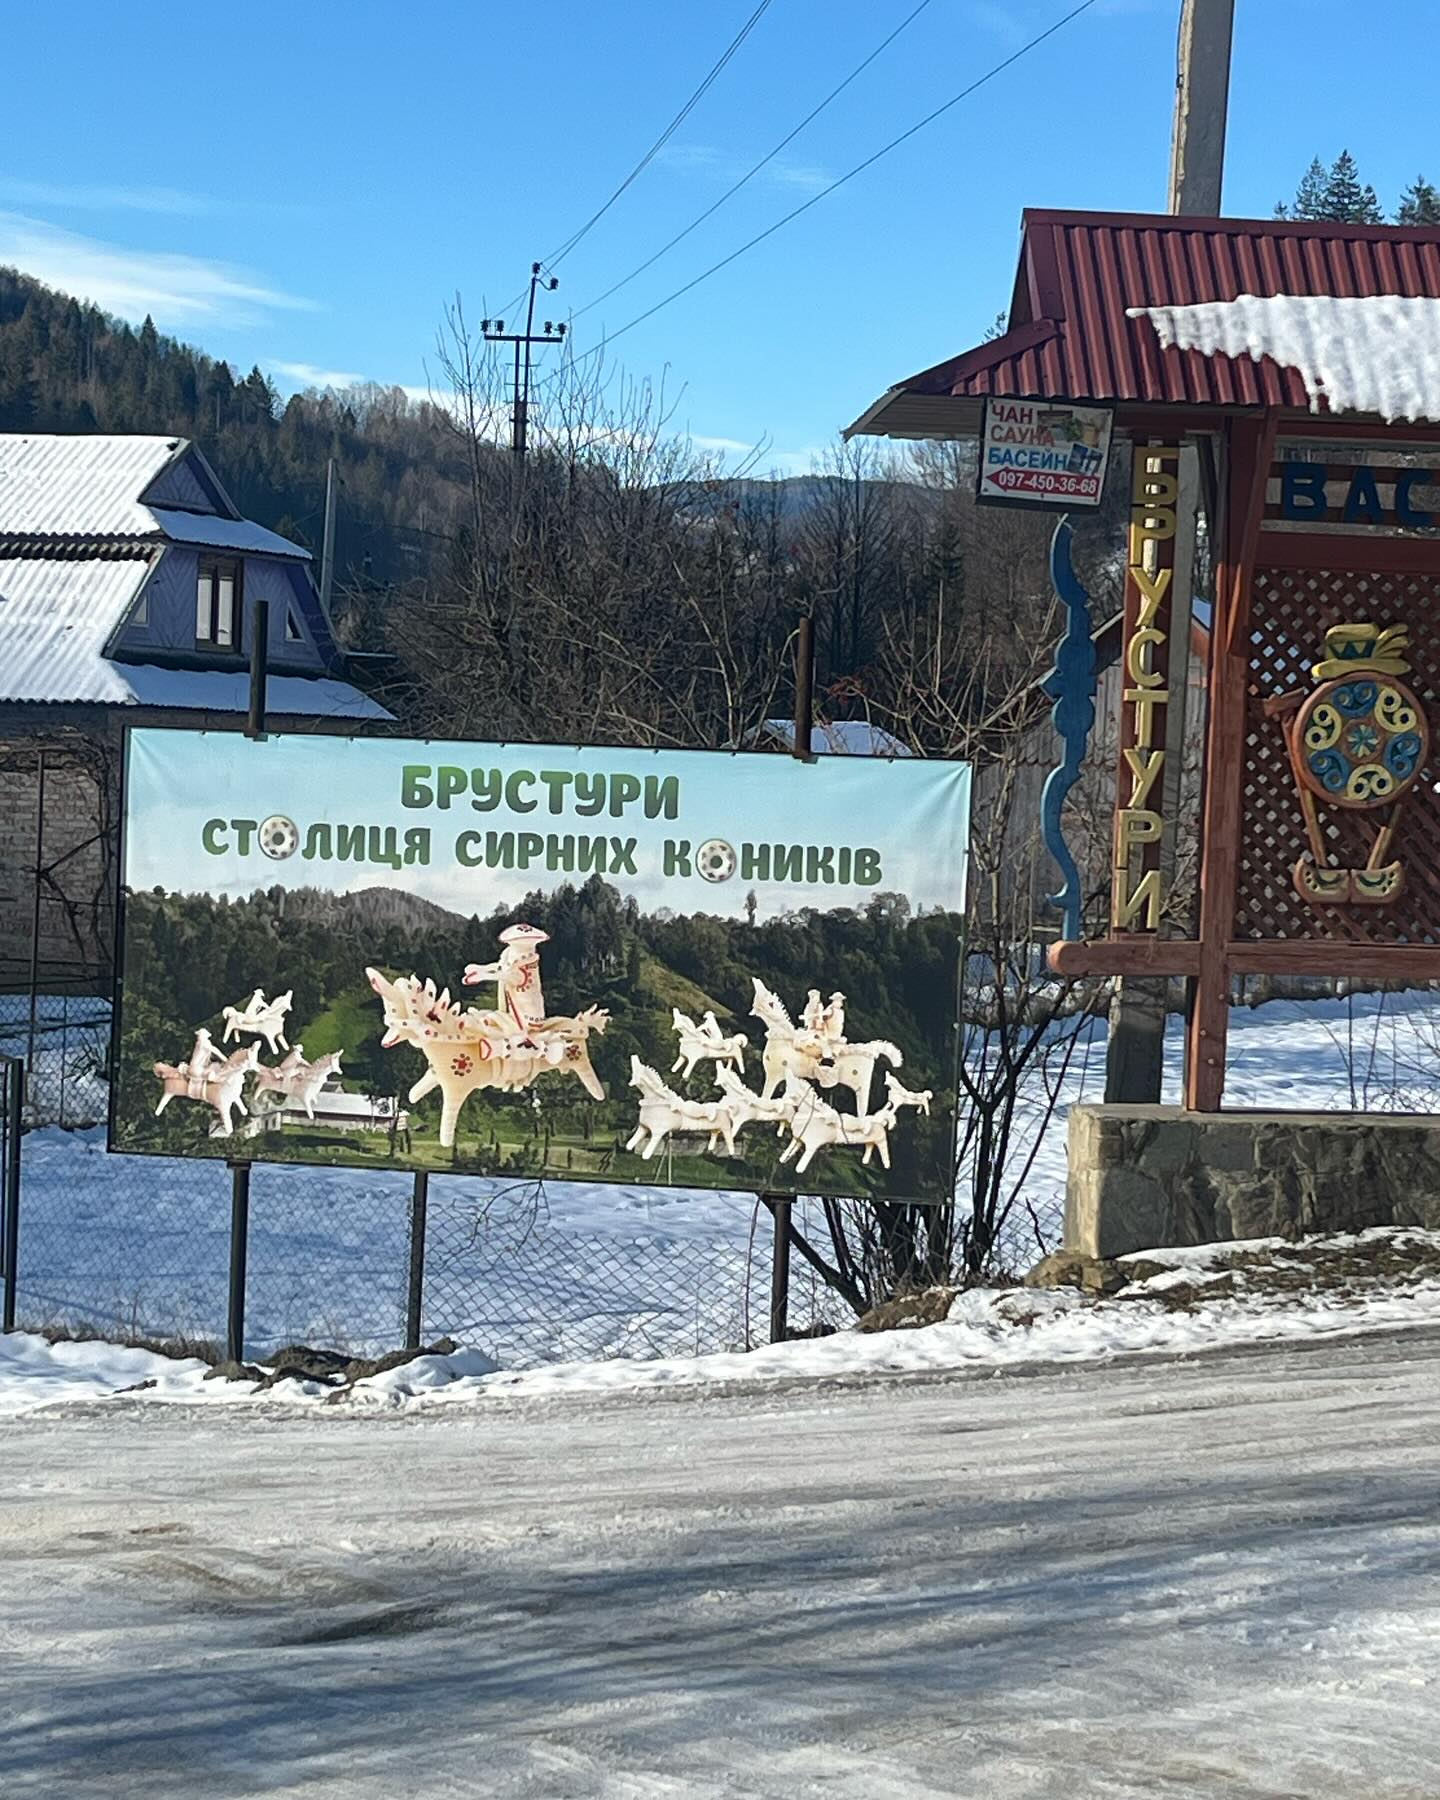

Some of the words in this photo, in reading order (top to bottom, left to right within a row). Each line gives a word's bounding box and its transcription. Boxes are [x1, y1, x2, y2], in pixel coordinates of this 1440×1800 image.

[992, 403, 1033, 424] ЧАН
[990, 424, 1056, 447] САУНА
[987, 447, 1067, 471] БАСЕЙН
[998, 470, 1098, 494] 097-450-36-68
[1283, 462, 1433, 527] ВАС
[1112, 447, 1179, 929] БРУСТУРИ
[401, 765, 679, 820] БРУСТУРИ
[202, 814, 431, 871] СТОЛИЦЯ
[455, 830, 638, 875] СИРНИХ
[663, 837, 882, 887] КОНИКІВ
